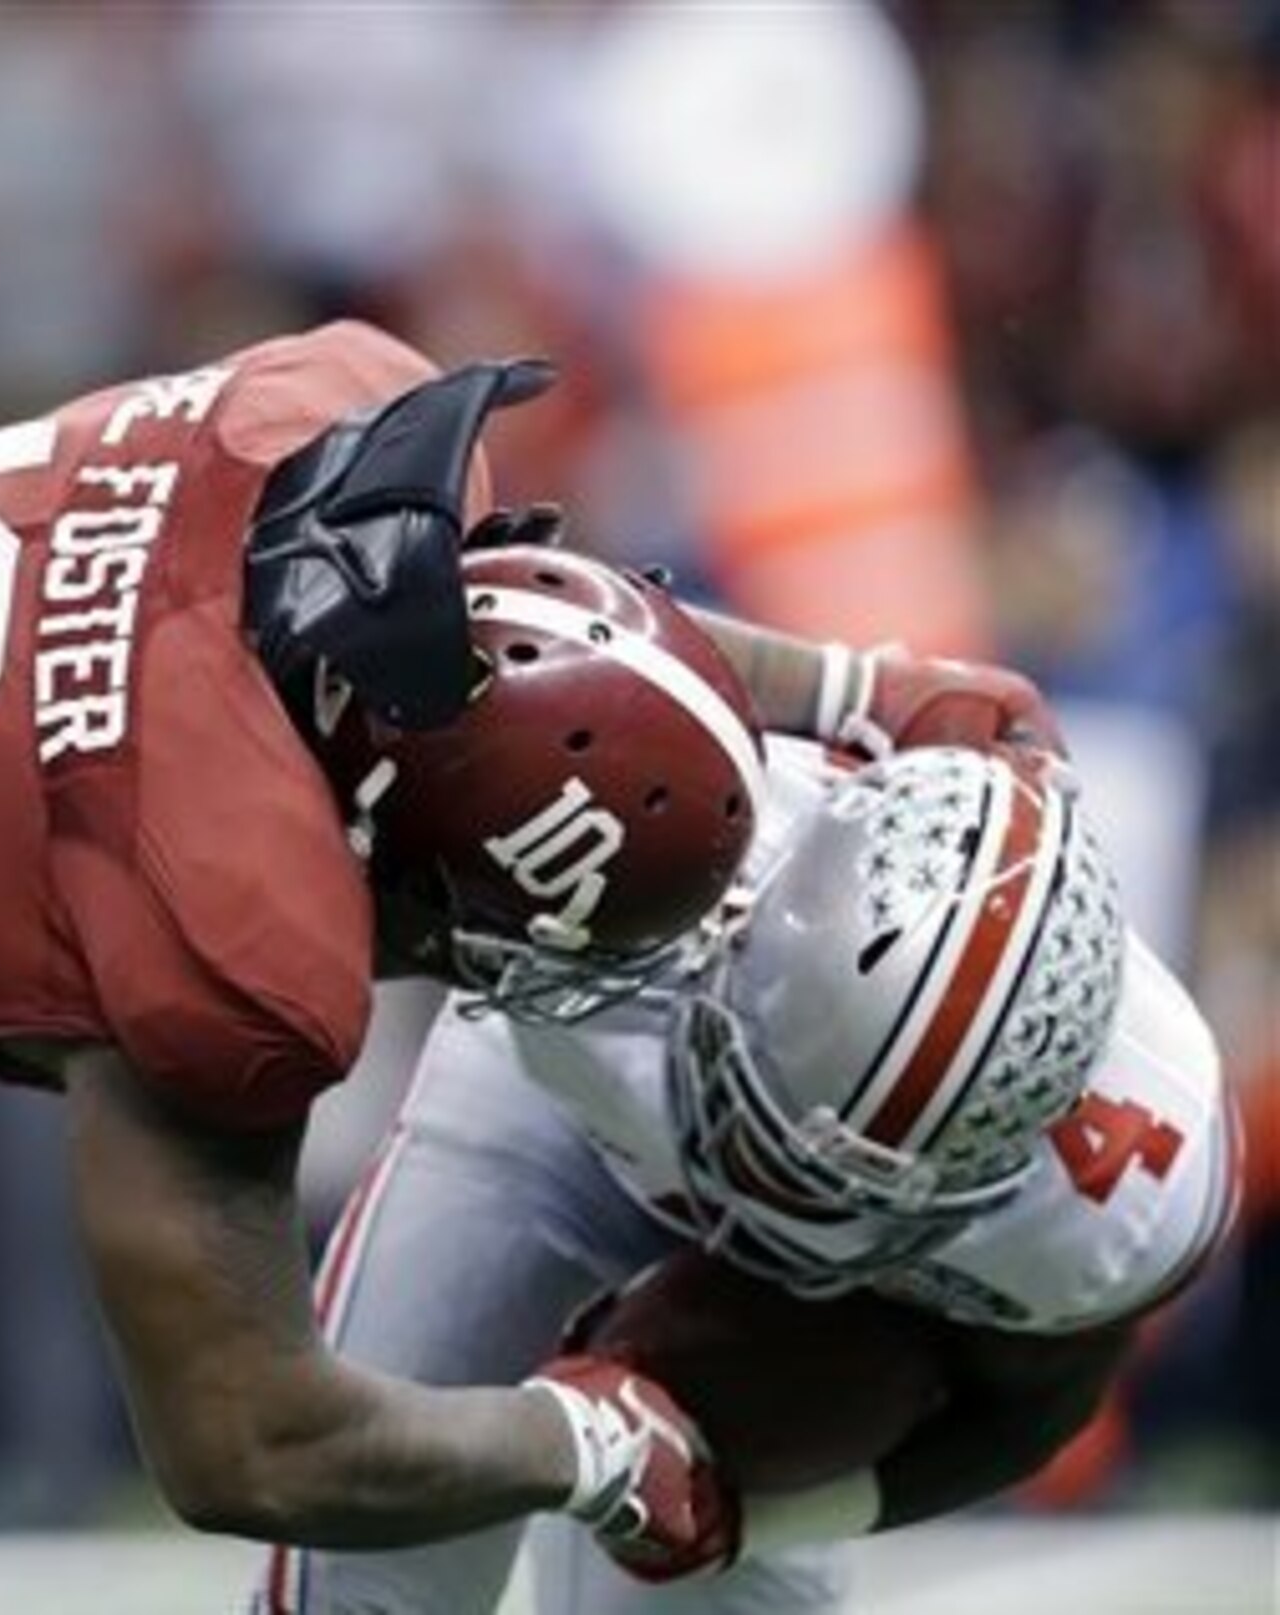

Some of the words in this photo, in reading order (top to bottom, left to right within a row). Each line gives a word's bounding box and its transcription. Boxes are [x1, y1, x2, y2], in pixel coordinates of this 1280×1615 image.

[32, 460, 180, 765] FOSTER
[481, 774, 627, 899] 10
[1045, 1090, 1186, 1206] 4
